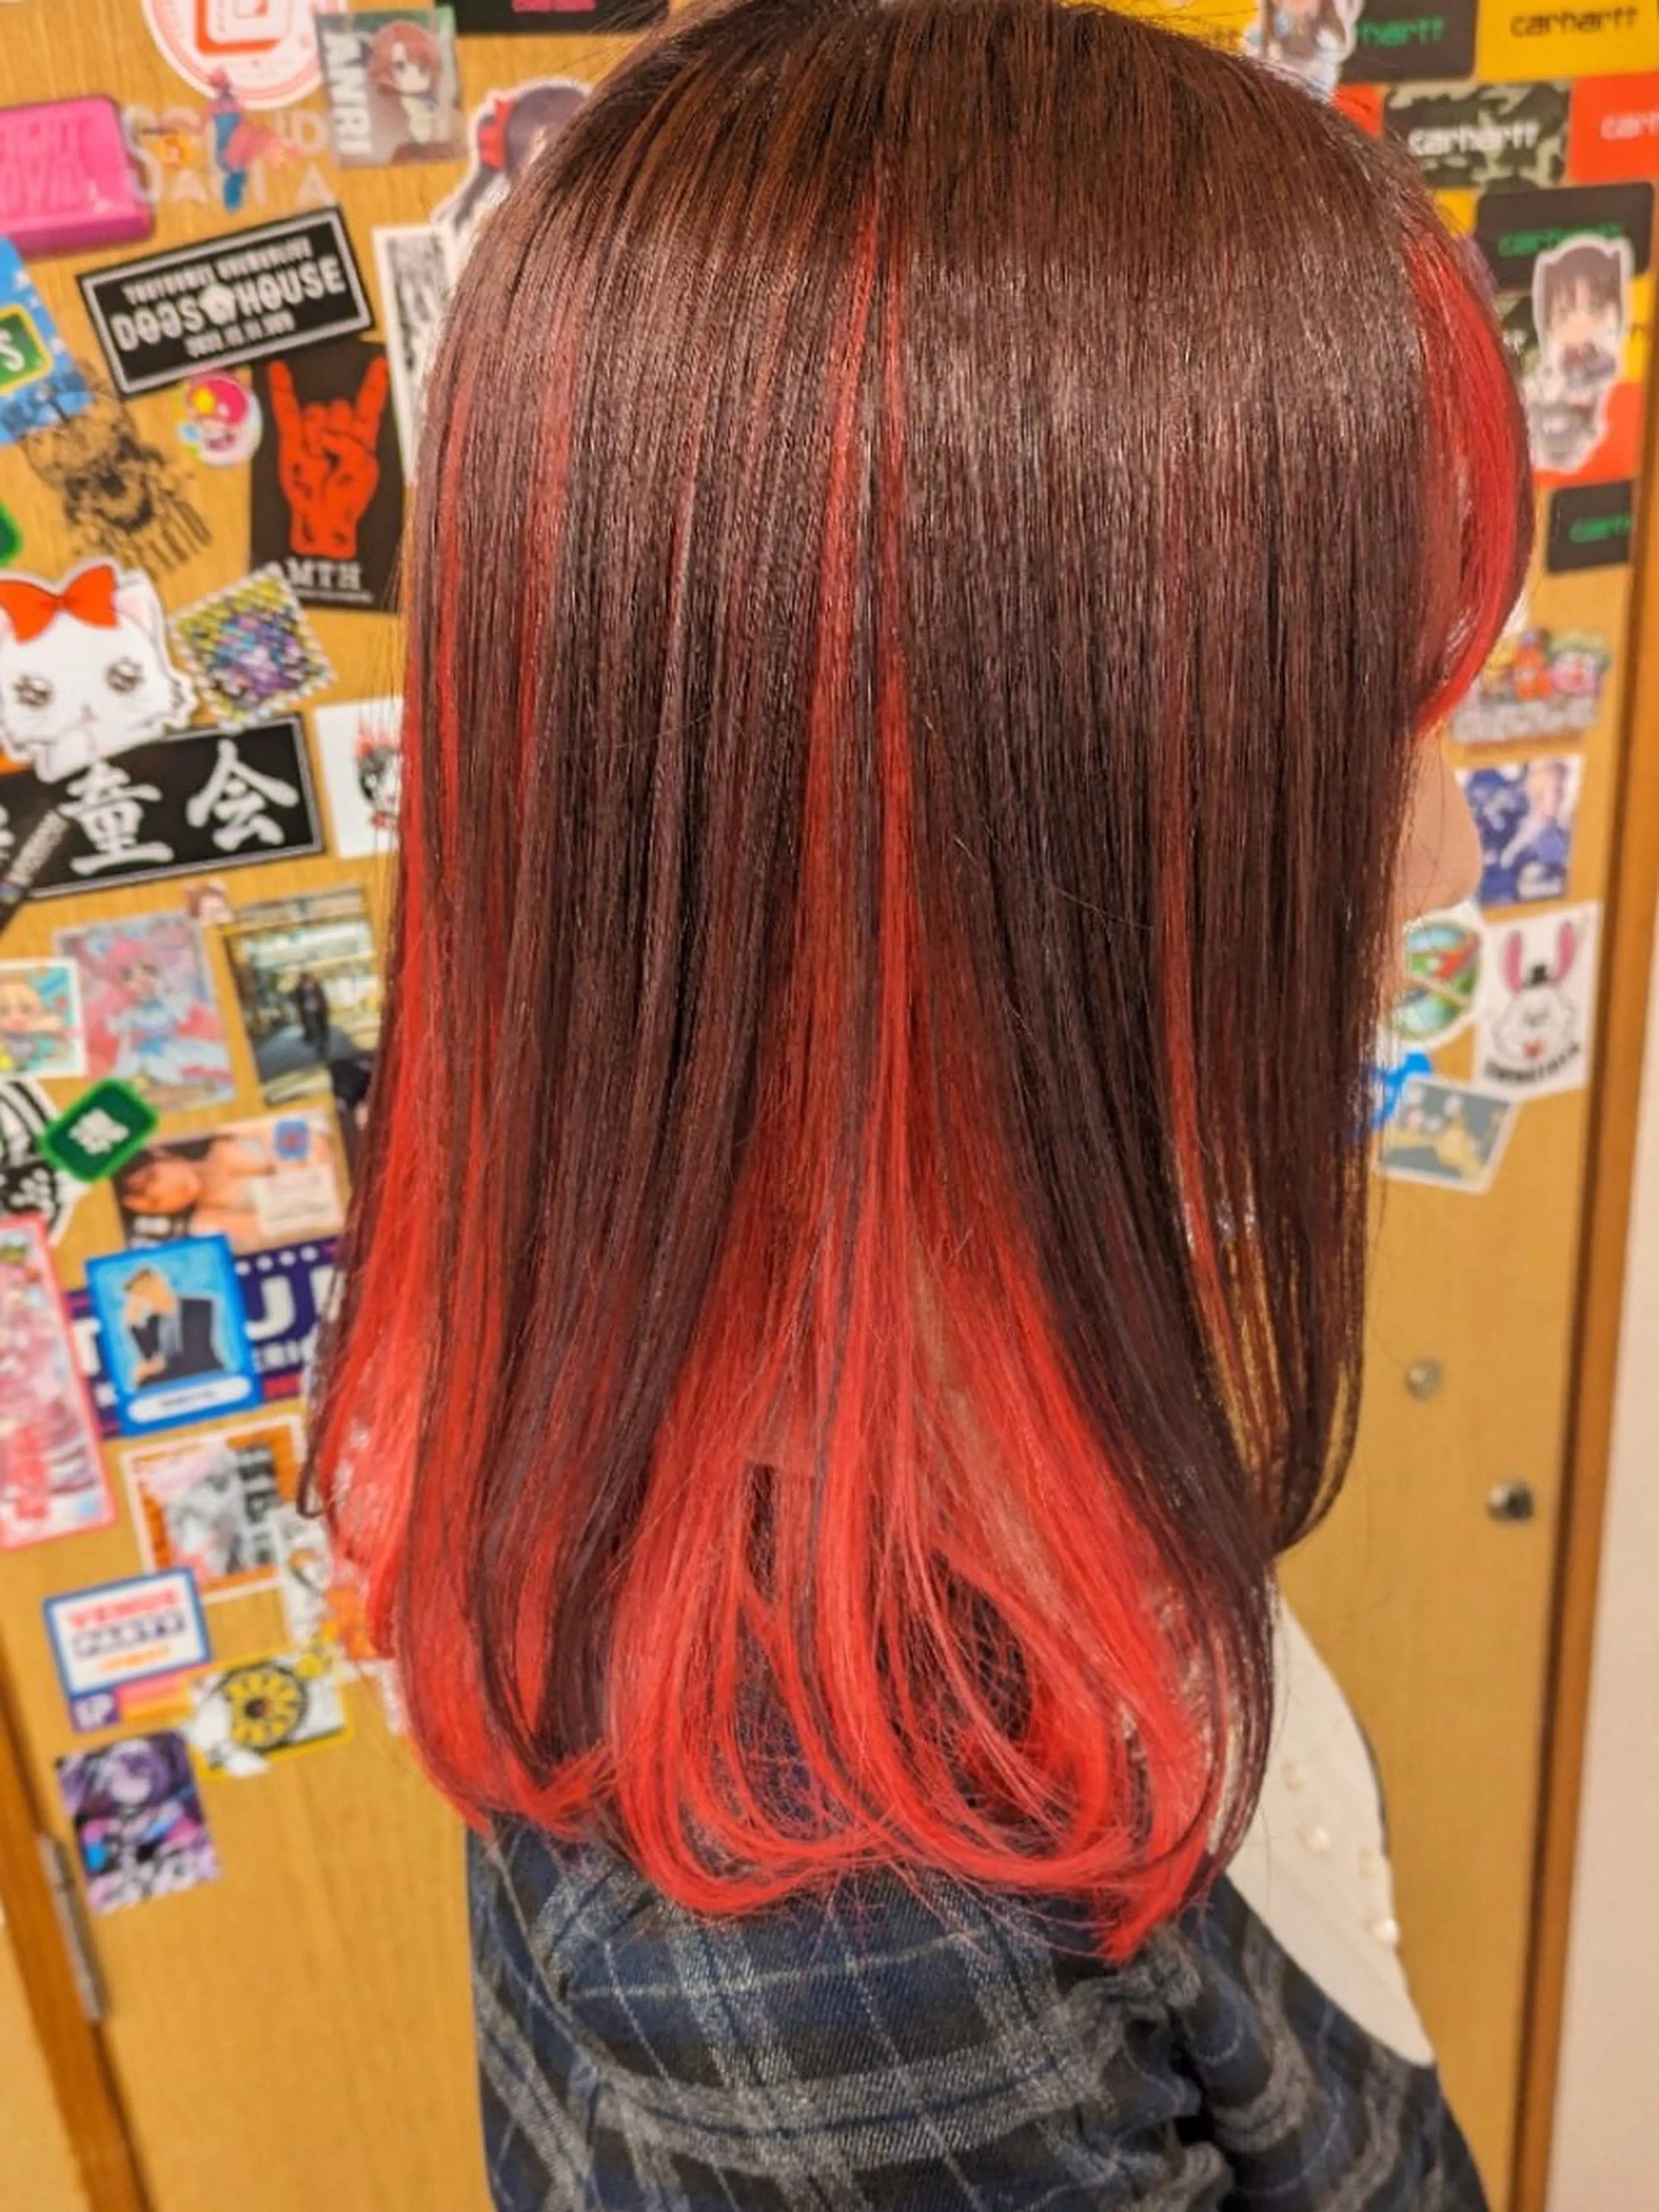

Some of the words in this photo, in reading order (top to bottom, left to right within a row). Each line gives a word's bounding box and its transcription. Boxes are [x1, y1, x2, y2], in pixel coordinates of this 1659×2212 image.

[1359, 17, 1444, 46] hartt
[1509, 6, 1638, 38] carhartt
[235, 256, 346, 315] HOUSE
[0, 741, 299, 876] 童会
